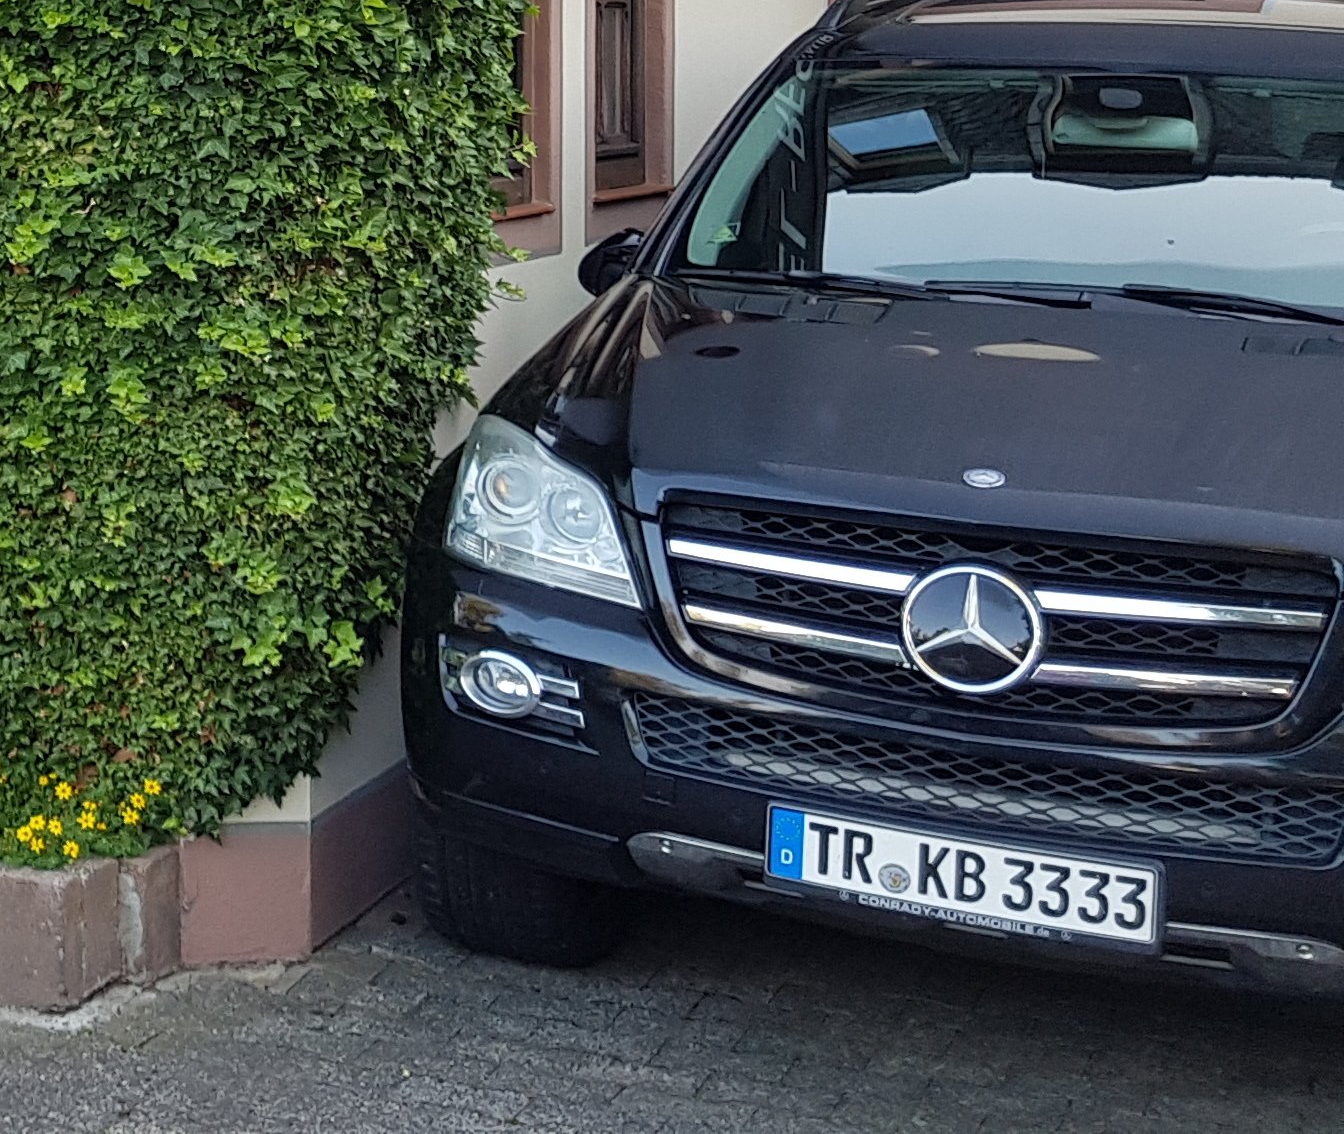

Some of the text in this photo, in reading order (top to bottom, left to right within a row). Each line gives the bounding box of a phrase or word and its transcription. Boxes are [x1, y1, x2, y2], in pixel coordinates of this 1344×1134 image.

[780, 848, 793, 865] D
[809, 822, 1149, 931] TR KB 3333
